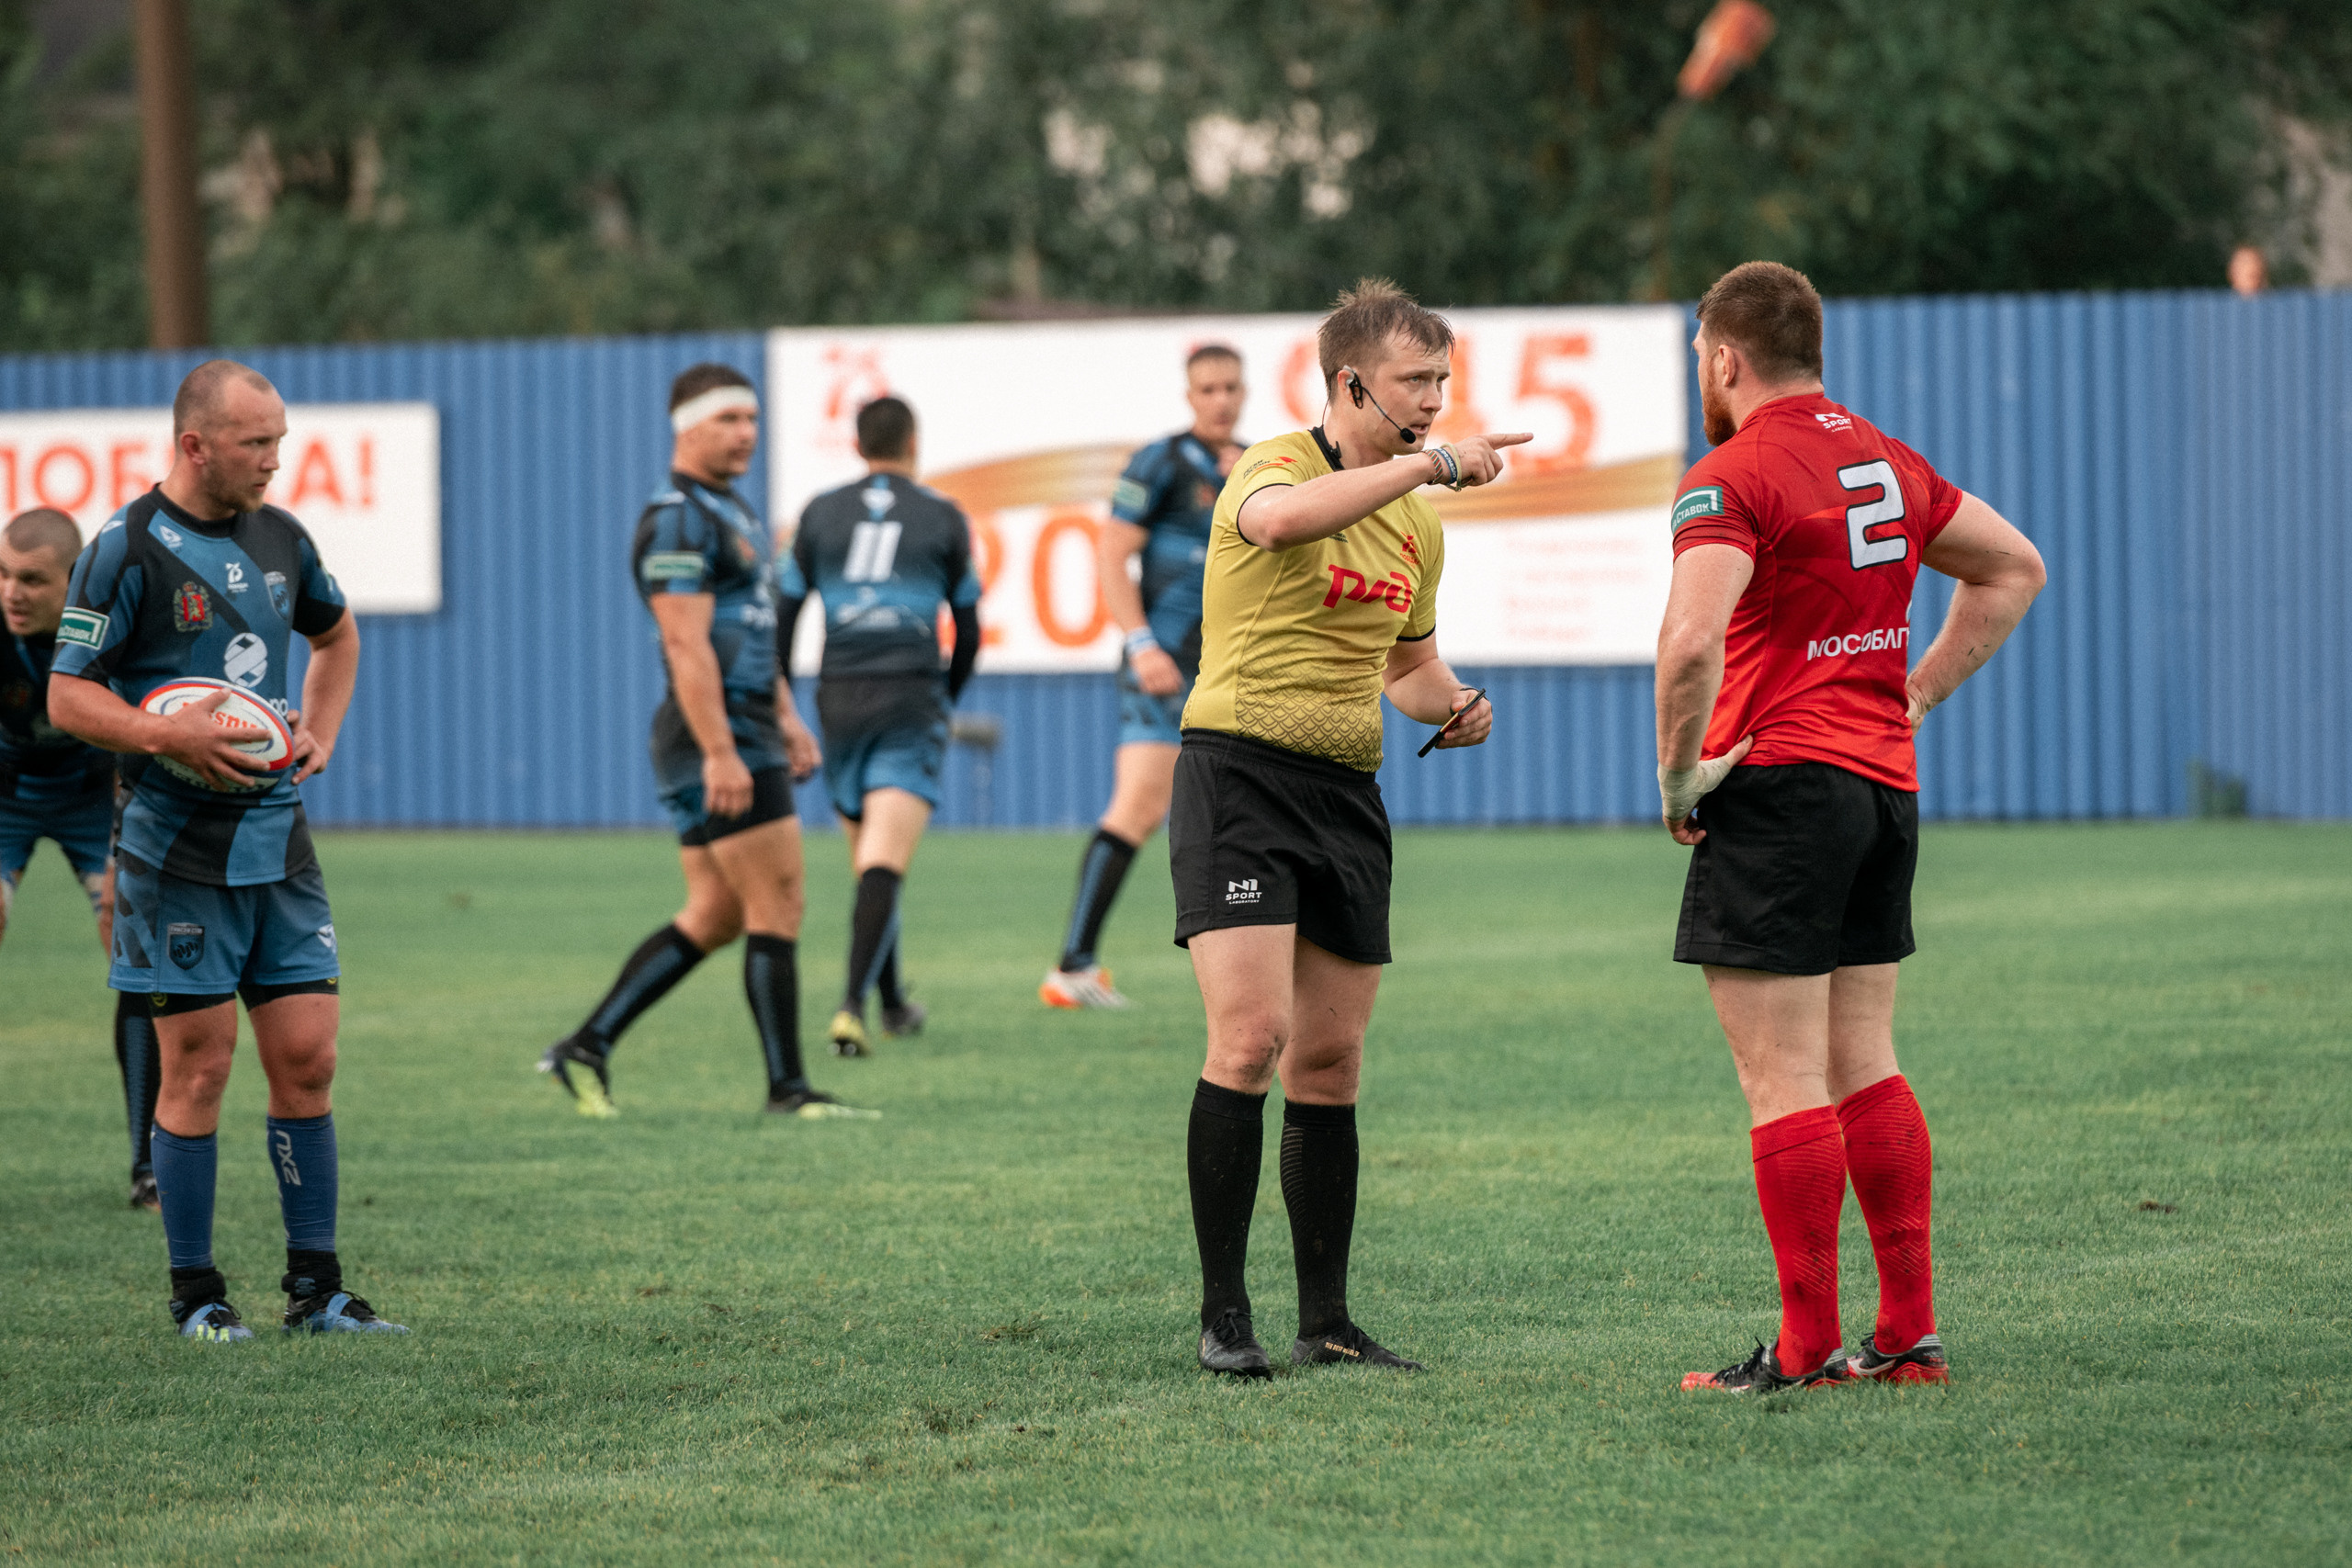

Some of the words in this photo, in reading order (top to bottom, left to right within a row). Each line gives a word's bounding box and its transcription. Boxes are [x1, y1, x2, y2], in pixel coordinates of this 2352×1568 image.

[1837, 458, 1908, 571] 2
[843, 520, 902, 582] 11
[1226, 892, 1262, 900] SPORT
[276, 1130, 301, 1186] 2XU
